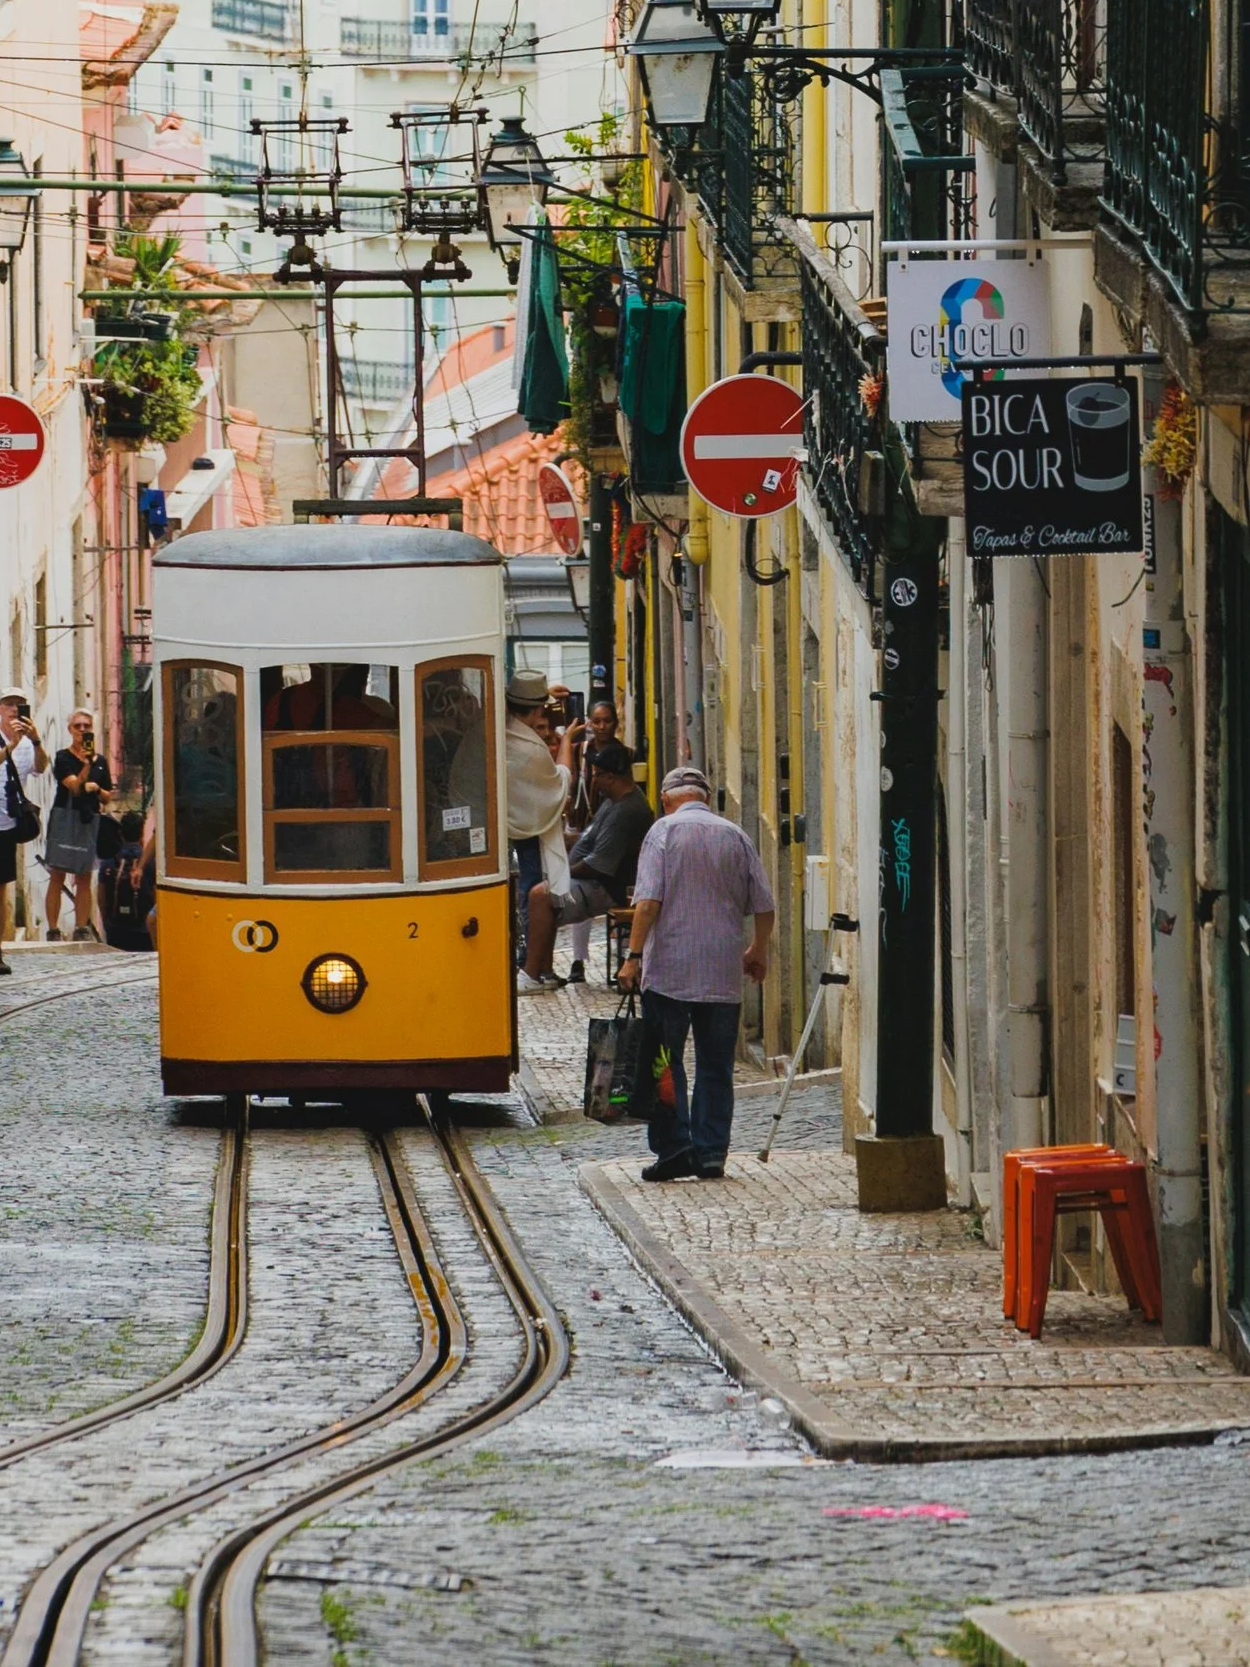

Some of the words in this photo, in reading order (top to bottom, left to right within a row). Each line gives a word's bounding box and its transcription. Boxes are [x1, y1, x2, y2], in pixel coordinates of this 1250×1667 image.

[910, 322, 1030, 358] CHOCLO
[970, 393, 1050, 437] BICA
[972, 447, 1065, 492] SOUR
[973, 525, 1018, 551] Tapas
[1020, 524, 1035, 549] &
[1038, 525, 1096, 547] Cocktail
[1097, 521, 1131, 545] Bar
[407, 922, 420, 939] 2
